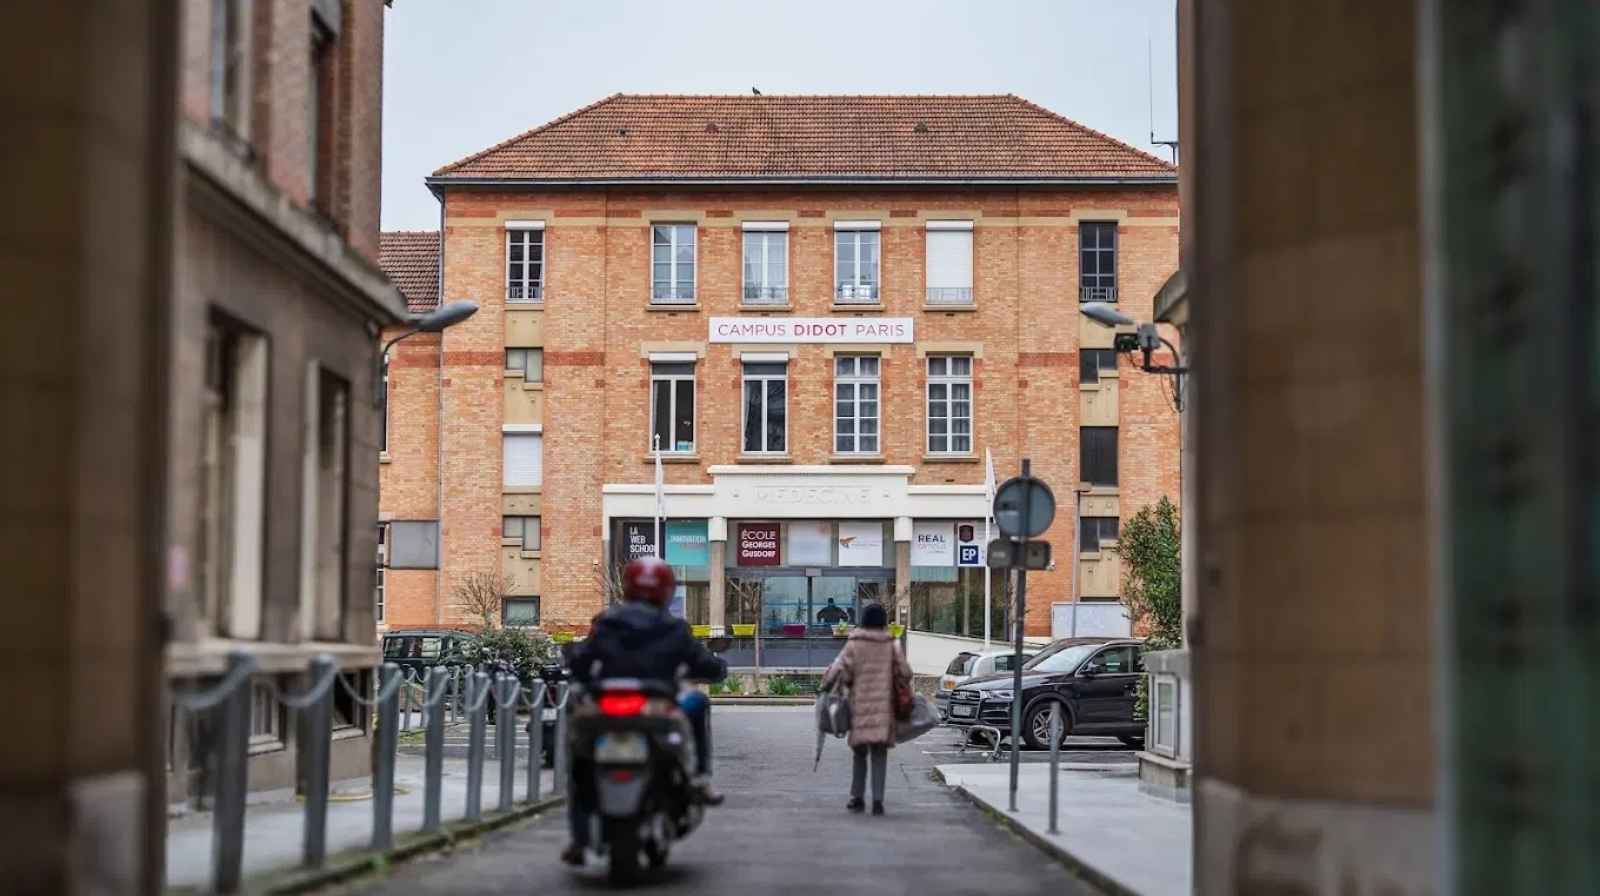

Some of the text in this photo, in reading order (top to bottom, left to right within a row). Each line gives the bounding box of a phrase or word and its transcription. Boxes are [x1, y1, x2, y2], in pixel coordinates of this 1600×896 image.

[718, 324, 905, 337] CAMPUS DIDOT PARIS
[630, 526, 638, 535] LA
[742, 529, 776, 540] ÉCOLE
[630, 535, 646, 544] WEB
[918, 534, 945, 543] REAL
[962, 548, 976, 561] EP
